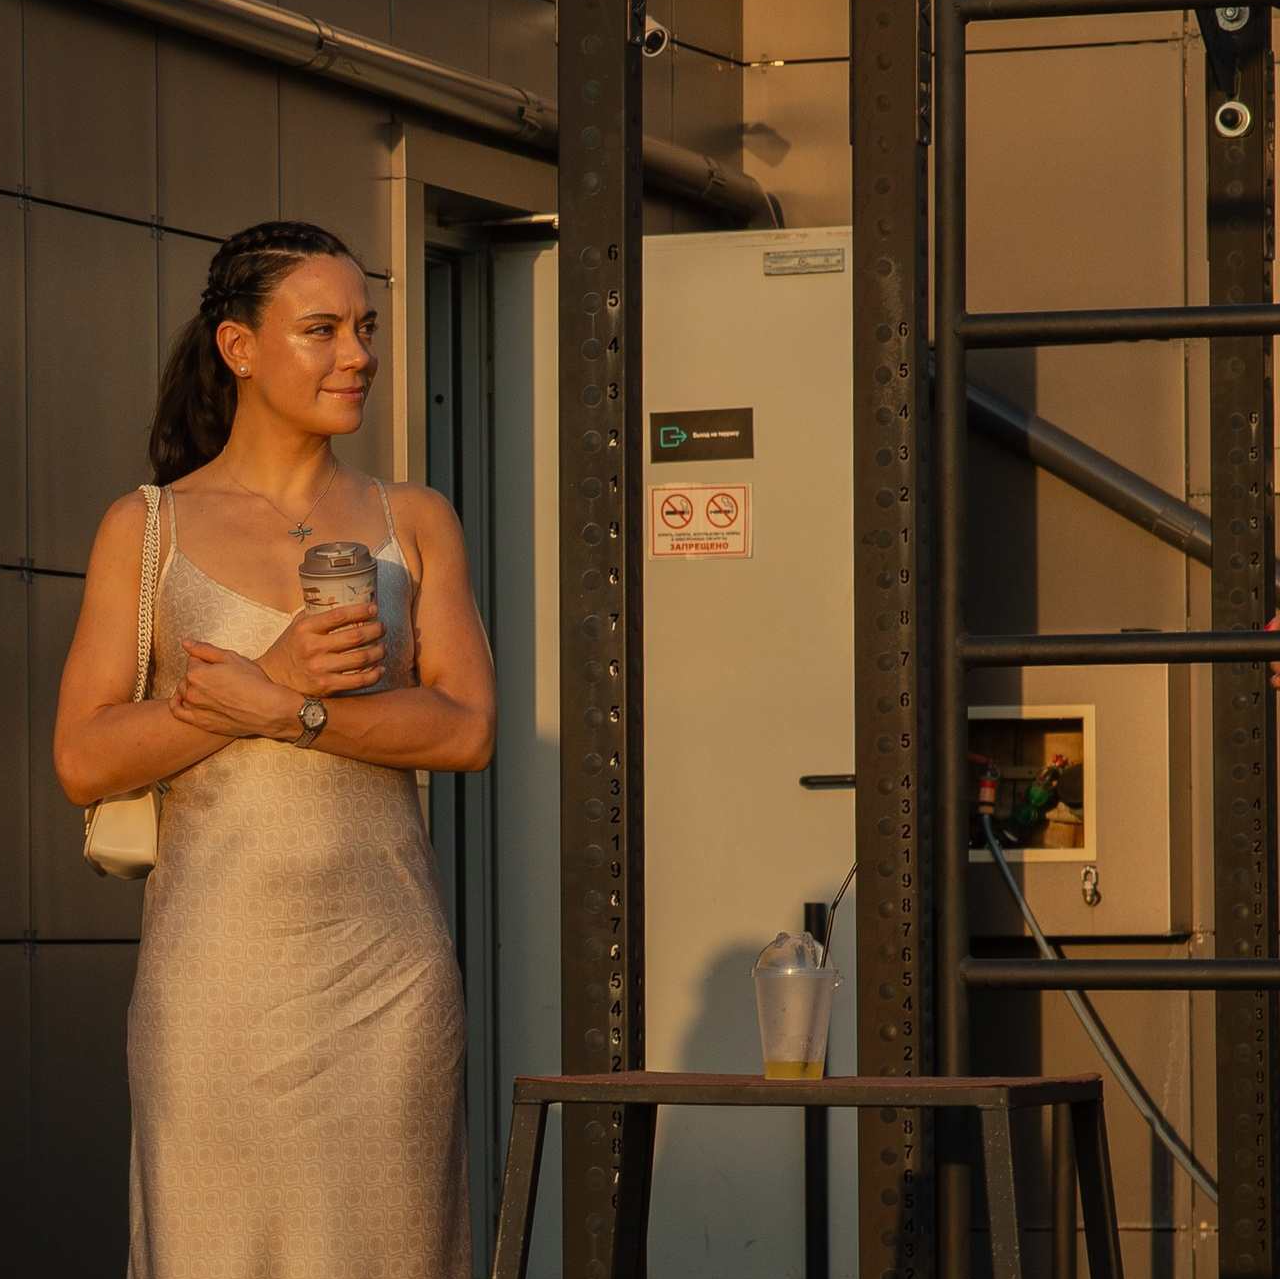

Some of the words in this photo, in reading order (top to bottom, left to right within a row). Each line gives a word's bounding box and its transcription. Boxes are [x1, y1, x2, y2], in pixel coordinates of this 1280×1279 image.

[607, 244, 619, 261] 6
[607, 291, 619, 308] 5
[898, 322, 908, 337] 6
[607, 337, 620, 354] 4
[899, 363, 909, 378] 5
[607, 383, 619, 400] 3
[898, 404, 909, 420] 4
[1249, 412, 1258, 425] 6
[608, 429, 620, 447] 2
[899, 446, 909, 461] 3
[1250, 447, 1258, 459] 5
[608, 475, 618, 493] 1
[1250, 482, 1259, 494] 4
[899, 487, 909, 502] 2
[609, 522, 620, 539] 9
[1251, 517, 1259, 530] 3
[900, 528, 908, 543] 1
[669, 542, 729, 551] ЗАПРЕЩЕНО
[1250, 552, 1260, 565] 2
[608, 567, 620, 585] 8
[900, 569, 910, 584] 9
[609, 613, 620, 631] 7
[899, 611, 910, 625] 8
[900, 652, 910, 667] 7
[608, 659, 620, 677] 6
[900, 693, 910, 707] 6
[1251, 692, 1261, 705] 7
[609, 706, 620, 723] 5
[1251, 727, 1261, 740] 6
[900, 734, 911, 749] 5
[609, 752, 621, 769] 4
[1252, 762, 1261, 776] 5
[610, 779, 621, 796] 3
[900, 775, 911, 790] 4
[901, 799, 911, 815] 3
[1252, 798, 1262, 810] 4
[610, 807, 621, 824] 2
[901, 824, 911, 839] 2
[1253, 818, 1262, 832] 3
[610, 835, 620, 852] 1
[1253, 839, 1262, 853] 2
[901, 849, 910, 864] 1
[610, 862, 622, 879] 9
[902, 874, 912, 888] 9
[1253, 882, 1263, 895] 9
[610, 890, 621, 907] 8
[901, 899, 912, 913] 8
[1253, 903, 1262, 915] 8
[610, 917, 622, 934] 7
[902, 923, 912, 938] 7
[1254, 924, 1263, 936] 7
[610, 944, 621, 962] 6
[901, 947, 912, 962] 6
[610, 973, 622, 990] 5
[902, 972, 912, 987] 5
[610, 1000, 623, 1017] 4
[902, 996, 913, 1012] 4
[1255, 1008, 1264, 1021] 3
[902, 1021, 913, 1036] 3
[1255, 1029, 1265, 1043] 2
[610, 1028, 622, 1045] 3
[903, 1046, 913, 1061] 2
[611, 1055, 622, 1073] 2
[1255, 1071, 1265, 1084] 9
[1255, 1092, 1265, 1105] 8
[611, 1110, 623, 1128] 9
[1256, 1113, 1265, 1126] 7
[903, 1120, 914, 1135] 8
[611, 1138, 622, 1155] 8
[1255, 1134, 1265, 1147] 6
[903, 1145, 914, 1160] 7
[1256, 1155, 1266, 1168] 5
[611, 1166, 621, 1184] 7
[904, 1169, 915, 1184] 6
[1256, 1177, 1266, 1189] 4
[904, 1194, 915, 1209] 5
[1257, 1197, 1266, 1211] 3
[904, 1218, 915, 1233] 4
[1257, 1218, 1267, 1232] 2
[905, 1243, 915, 1259] 3
